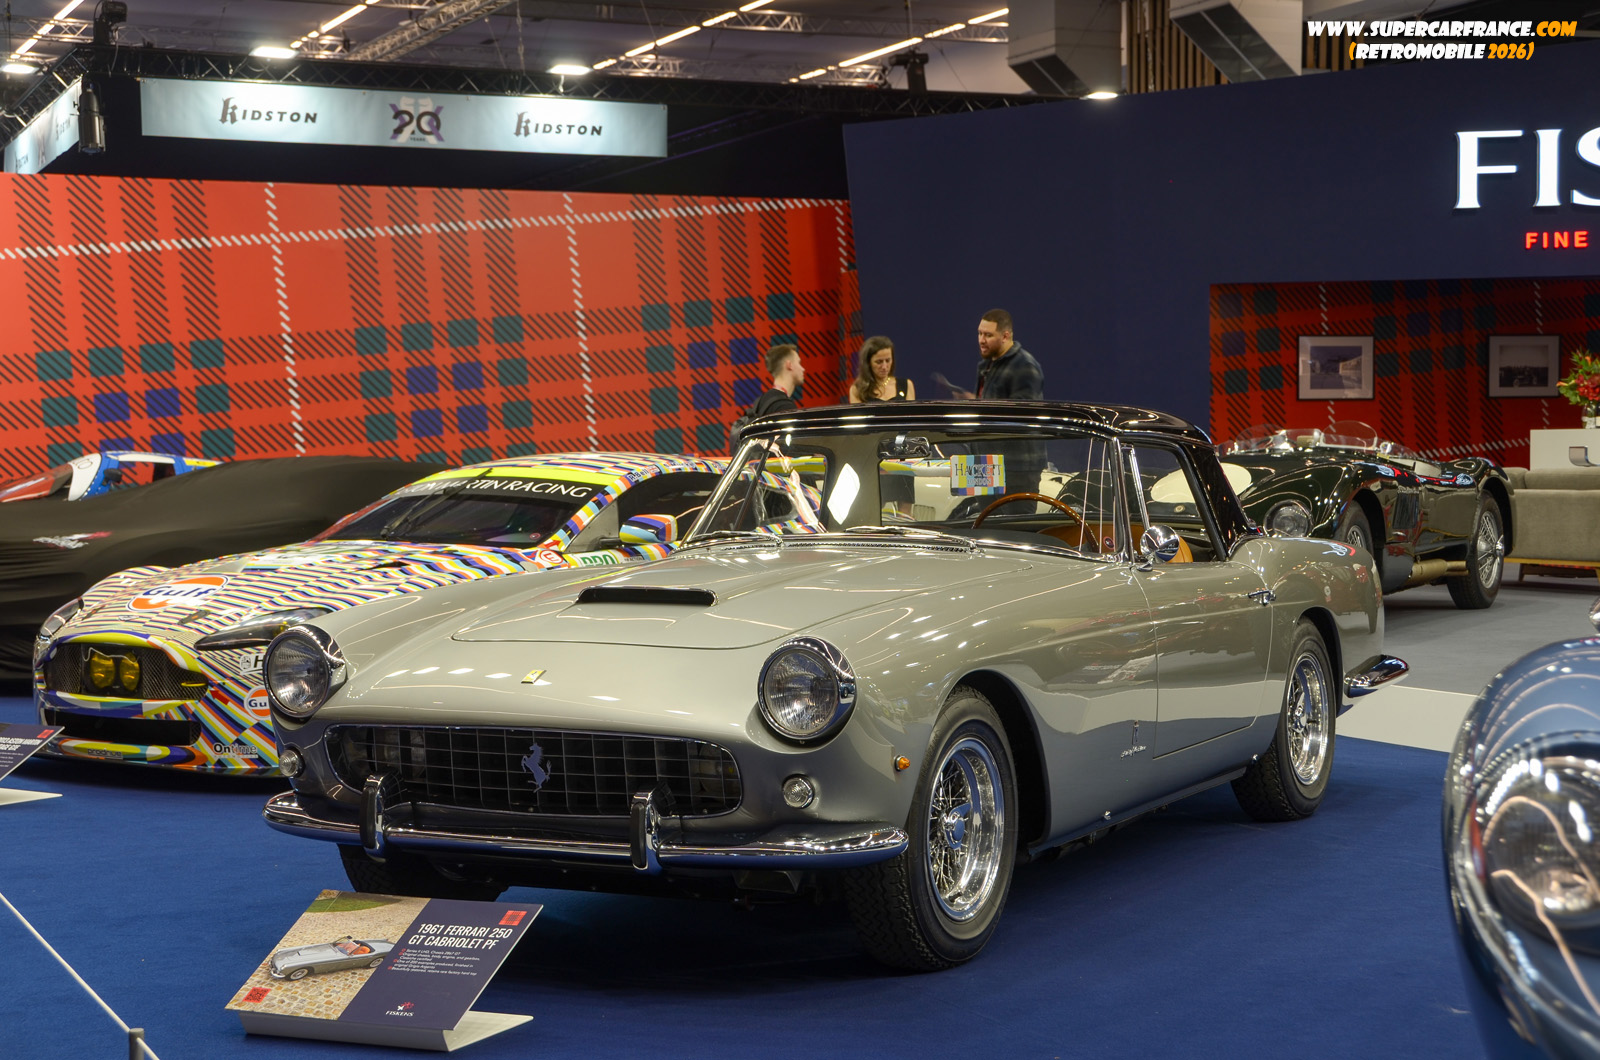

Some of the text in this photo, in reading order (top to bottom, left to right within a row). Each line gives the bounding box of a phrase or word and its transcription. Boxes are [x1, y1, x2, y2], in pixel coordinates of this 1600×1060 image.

[1525, 230, 1589, 249] FINE
[502, 480, 593, 498] RACING
[142, 585, 217, 598] Gulf
[248, 698, 267, 708] Gu
[213, 743, 258, 754] Ontime
[417, 923, 513, 939] 1961 FERRARI 250
[408, 934, 500, 950] GT CABRIOLET PF
